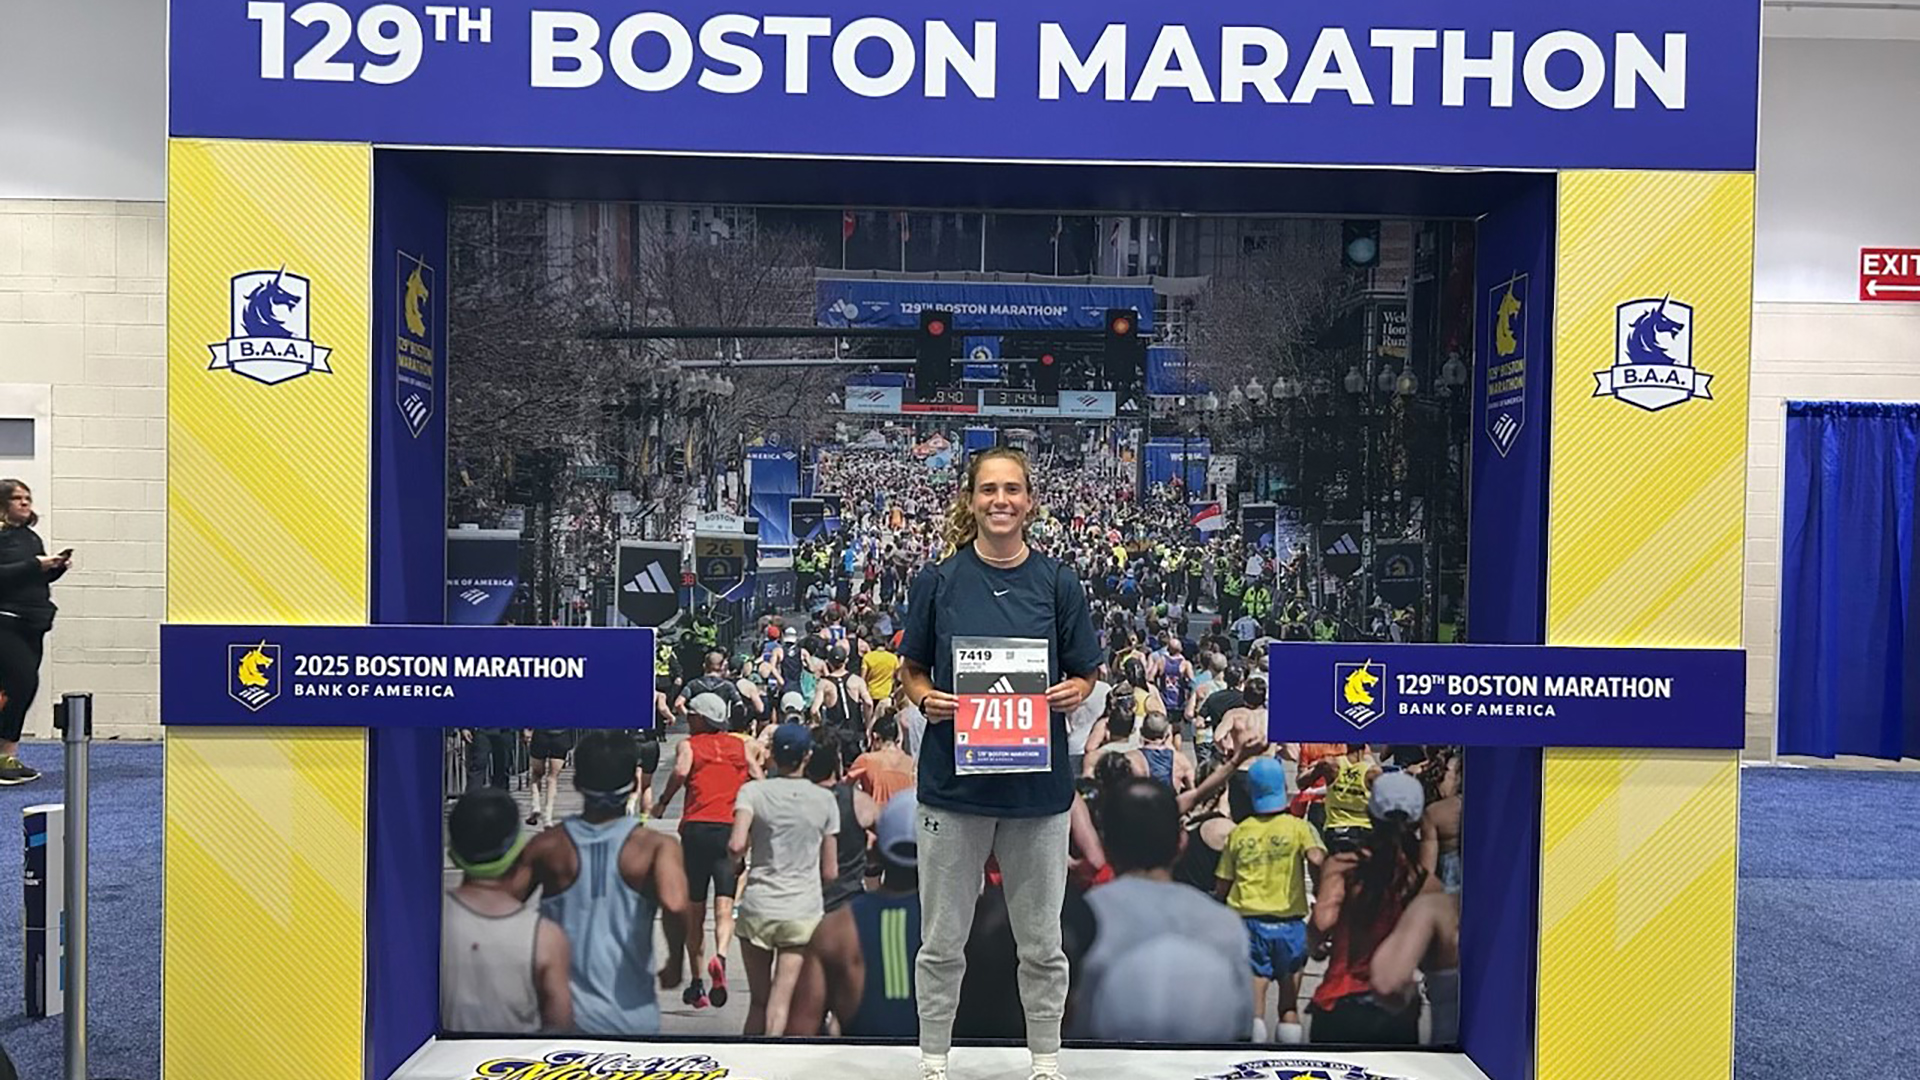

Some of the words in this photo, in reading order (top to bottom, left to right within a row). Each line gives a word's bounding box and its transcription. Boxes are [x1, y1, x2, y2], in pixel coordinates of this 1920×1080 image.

[247, 1, 492, 86] 129TH
[530, 10, 998, 101] BOSTON
[1038, 22, 1687, 111] MARATHON
[1863, 254, 1920, 276] EXIT
[901, 302, 933, 314] 129TH
[935, 303, 987, 316] BOSTON
[240, 341, 304, 359] B.A.A.
[1623, 368, 1686, 386] B.A.A.
[706, 542, 734, 556] 26
[959, 650, 993, 661] 7419
[294, 655, 349, 677] 2025
[355, 655, 448, 679] BOSTON
[454, 656, 585, 679] MARATHON
[294, 684, 346, 697] BANK
[348, 684, 370, 697] OF
[374, 685, 455, 698] AMERICA
[1396, 674, 1445, 695] 129TH
[1448, 674, 1538, 697] BOSTON
[1544, 676, 1671, 698] MARATHON
[970, 697, 1033, 730] 7419
[1398, 703, 1448, 715] BANK
[1451, 703, 1473, 715] OF
[1477, 703, 1557, 717] AMERICA
